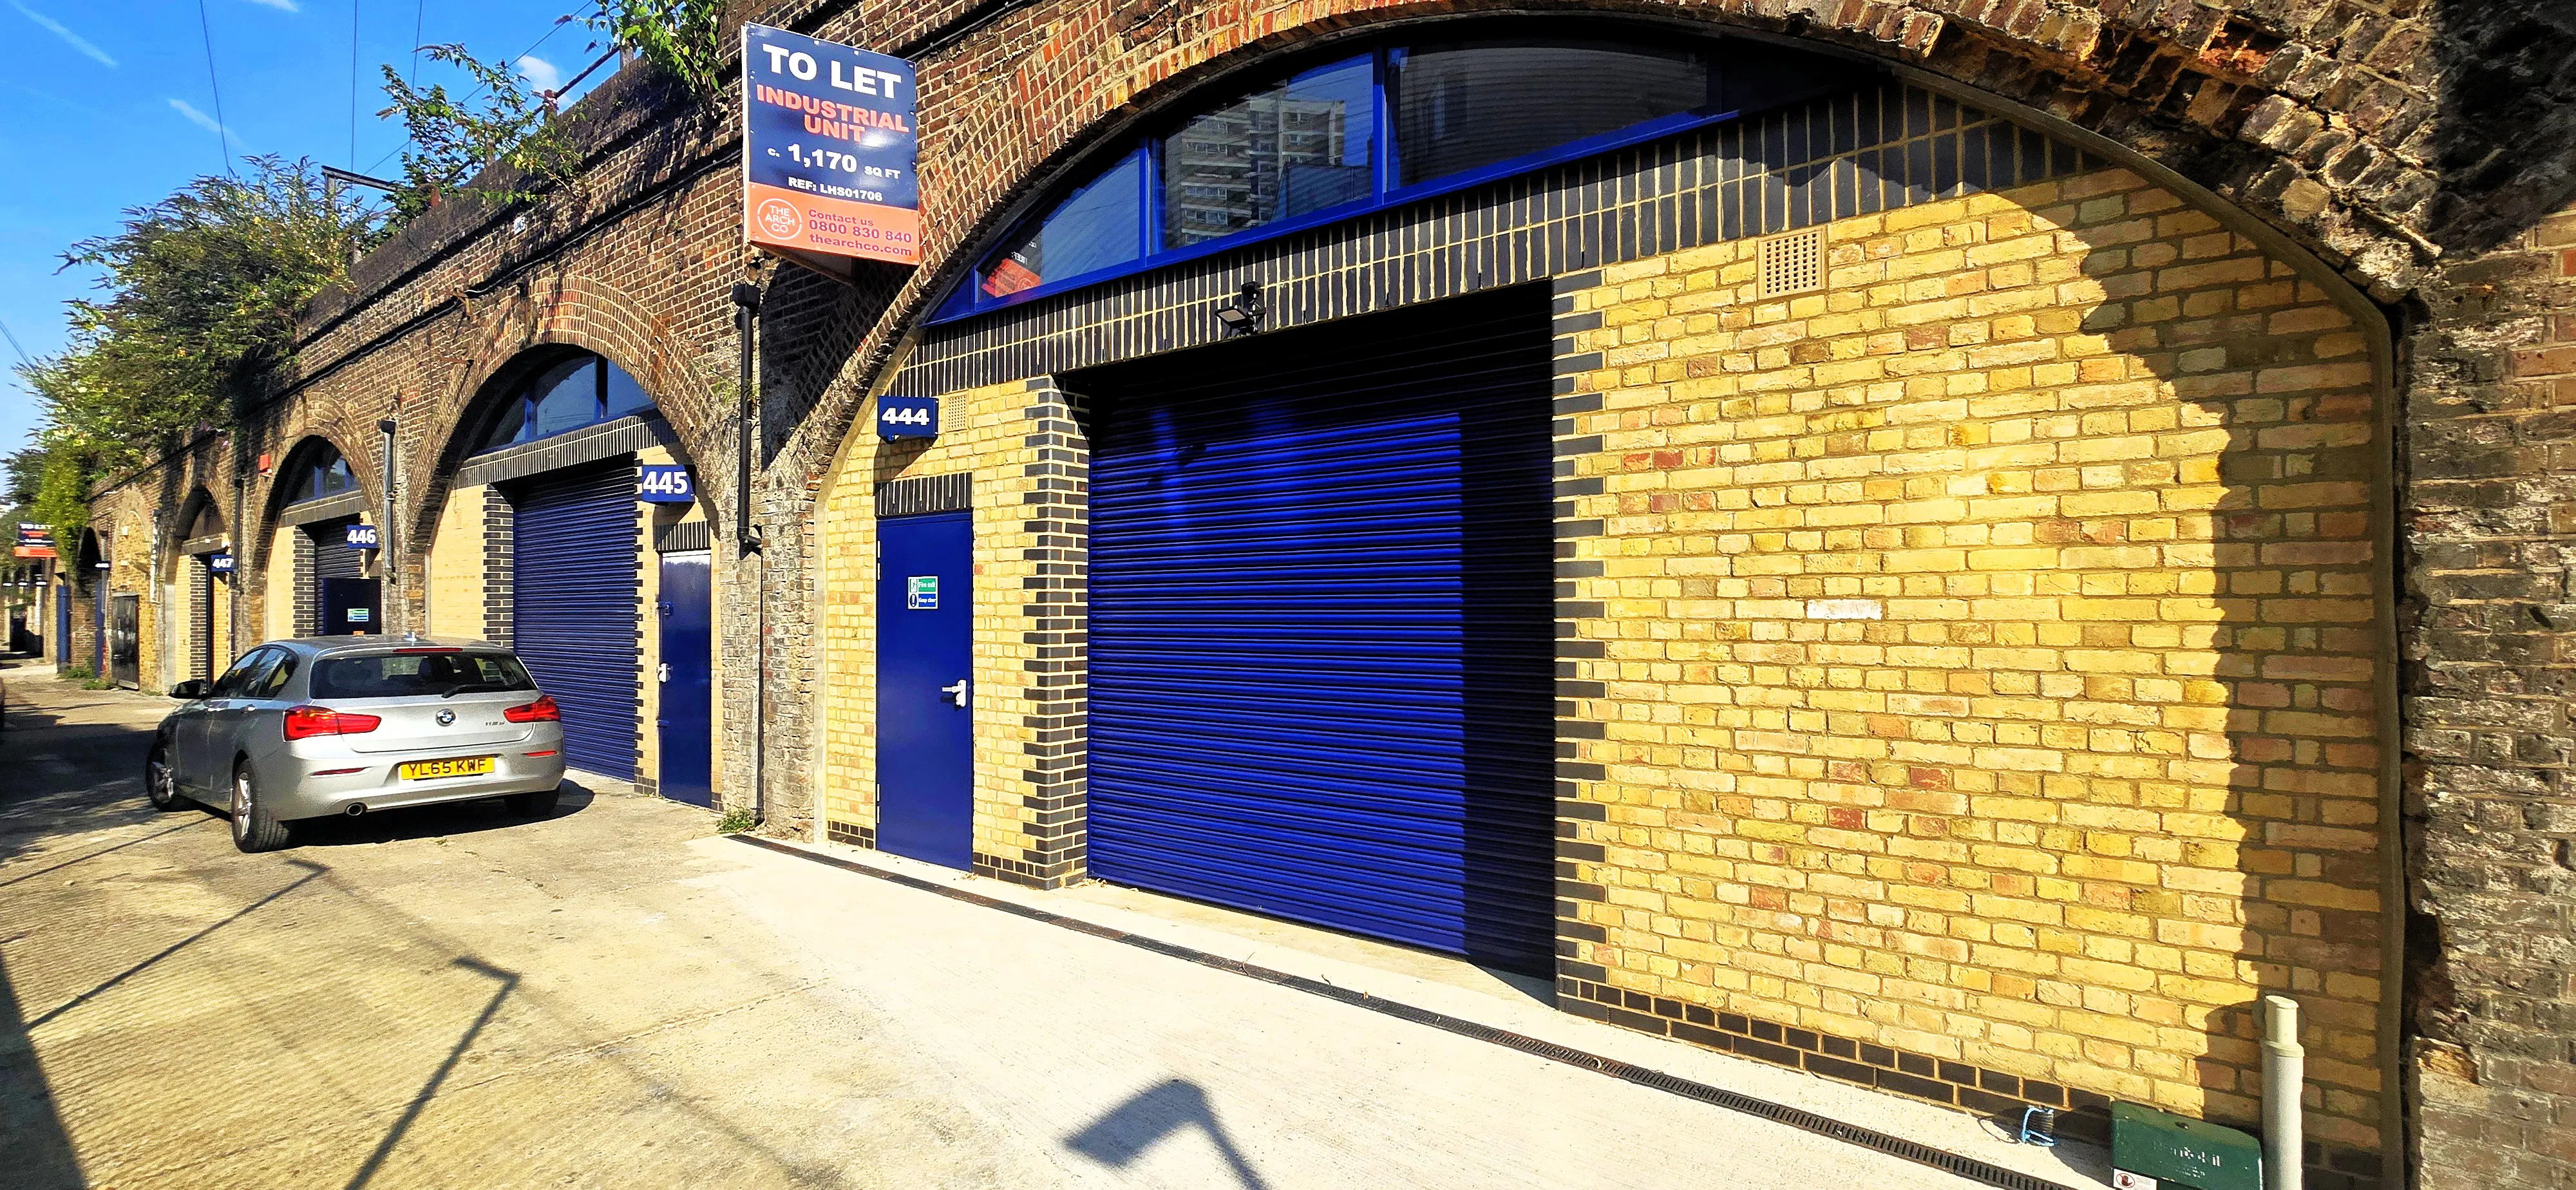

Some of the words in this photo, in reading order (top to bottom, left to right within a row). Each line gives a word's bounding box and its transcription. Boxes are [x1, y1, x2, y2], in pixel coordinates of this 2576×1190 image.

[762, 43, 817, 81] TO
[831, 60, 902, 99] LET
[757, 84, 909, 133] INDUSTRIAL
[804, 115, 866, 142] UNIT
[767, 147, 780, 157] c.
[788, 143, 857, 173] 1,170
[864, 165, 882, 177] SQ
[885, 169, 901, 179] FT
[788, 176, 817, 191] REF:
[820, 184, 883, 202] LHS01706
[765, 213, 795, 226] ARCH
[769, 205, 790, 217] THE
[808, 209, 857, 224] Contact
[860, 218, 874, 226] us
[771, 223, 788, 233] CO
[809, 220, 847, 234] 0800
[853, 226, 880, 239] 830
[886, 231, 912, 243] 840
[810, 234, 912, 256] thearchco.com
[882, 408, 930, 426] 444
[643, 471, 688, 494] 445
[347, 529, 376, 544] 446
[213, 558, 232, 568] 447
[408, 760, 451, 777] YL65
[456, 759, 487, 773] KWF
